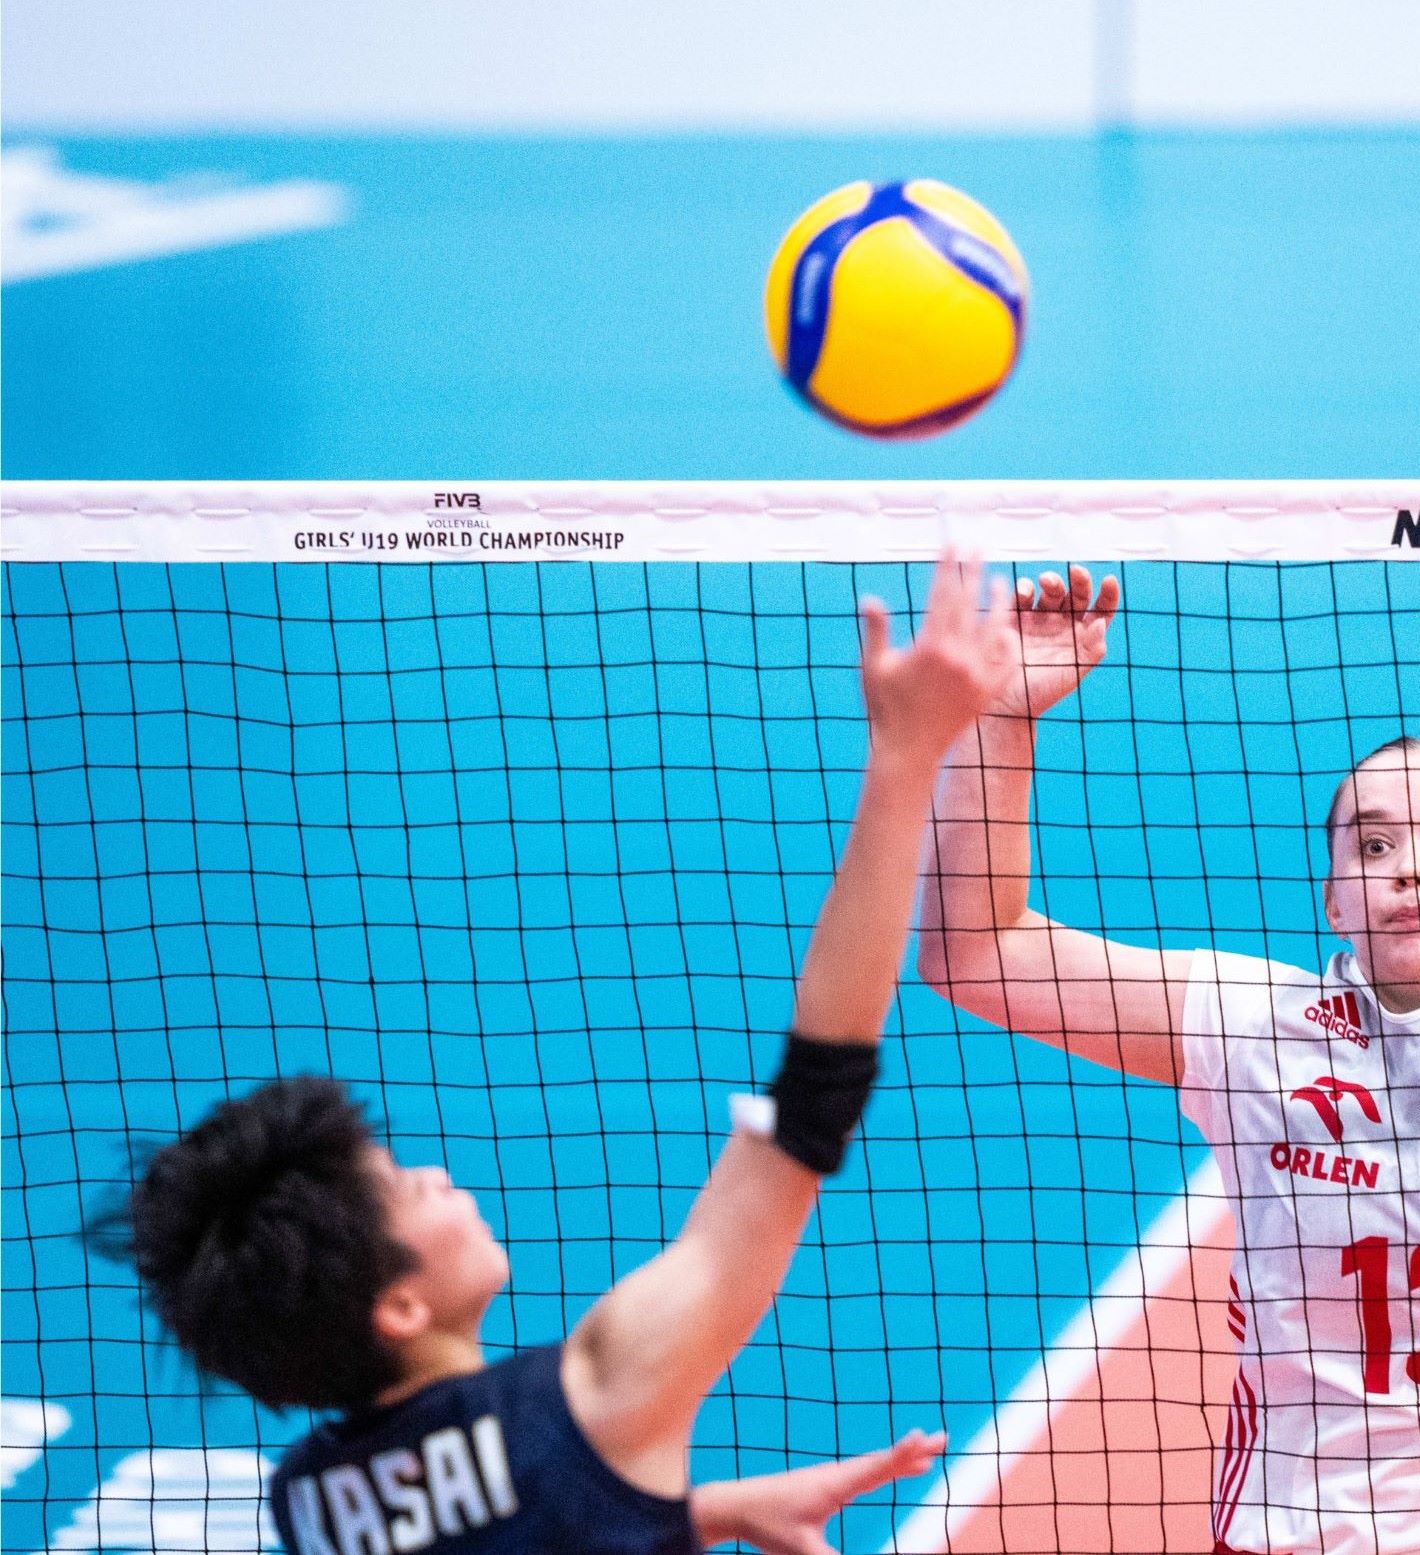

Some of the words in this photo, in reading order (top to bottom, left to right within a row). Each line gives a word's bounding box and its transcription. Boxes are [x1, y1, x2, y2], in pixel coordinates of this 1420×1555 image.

[434, 493, 481, 508] FIVB
[427, 519, 491, 529] VOLLEYBALL
[362, 532, 399, 549] U19
[406, 532, 473, 549] WORLD
[479, 532, 625, 550] CHAMPIONSHIP
[1304, 1003, 1370, 1050] adidas
[1270, 1142, 1380, 1189] ORLEN
[286, 1414, 518, 1555] KASAI
